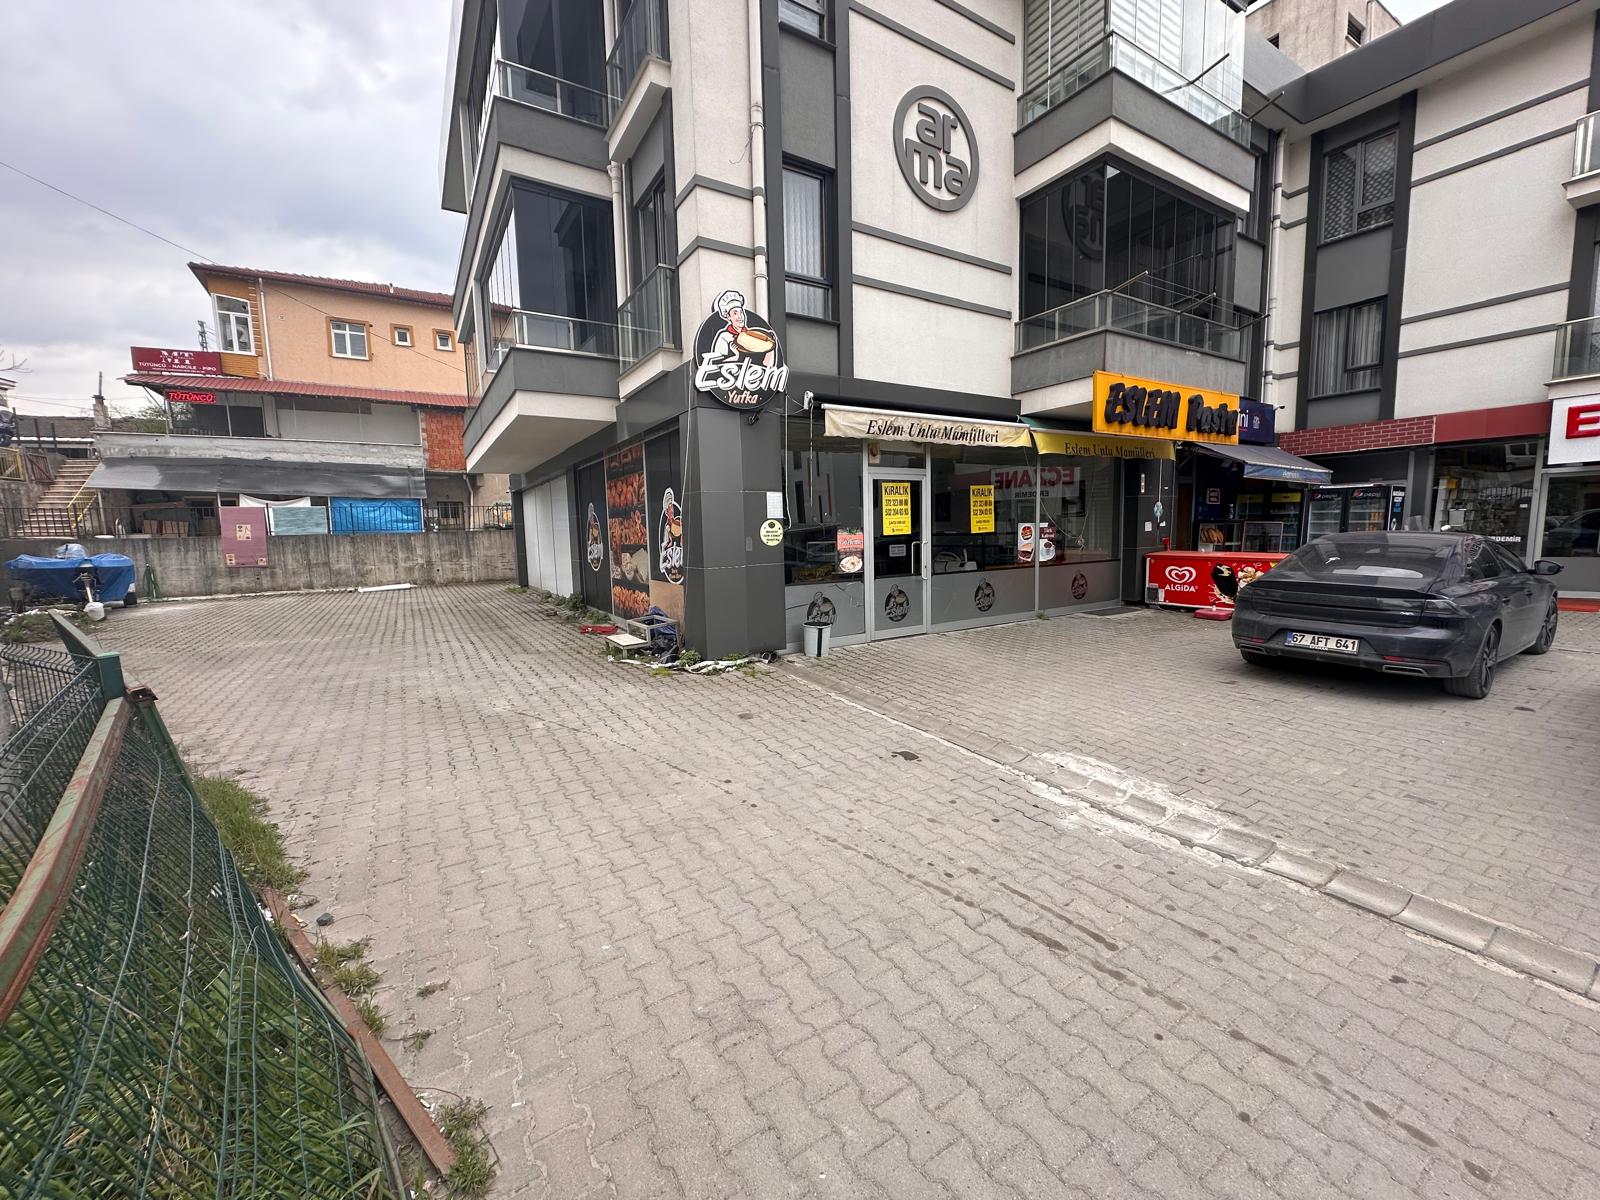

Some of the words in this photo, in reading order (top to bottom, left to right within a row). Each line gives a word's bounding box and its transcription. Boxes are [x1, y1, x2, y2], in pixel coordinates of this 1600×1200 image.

[695, 352, 789, 392] Eslem
[727, 391, 759, 404] Yufka
[866, 419, 904, 437] Eslem
[1065, 442, 1091, 455] Eslem
[1292, 633, 1305, 643] 67
[1310, 636, 1330, 646] AFT
[1335, 639, 1356, 650] 641
